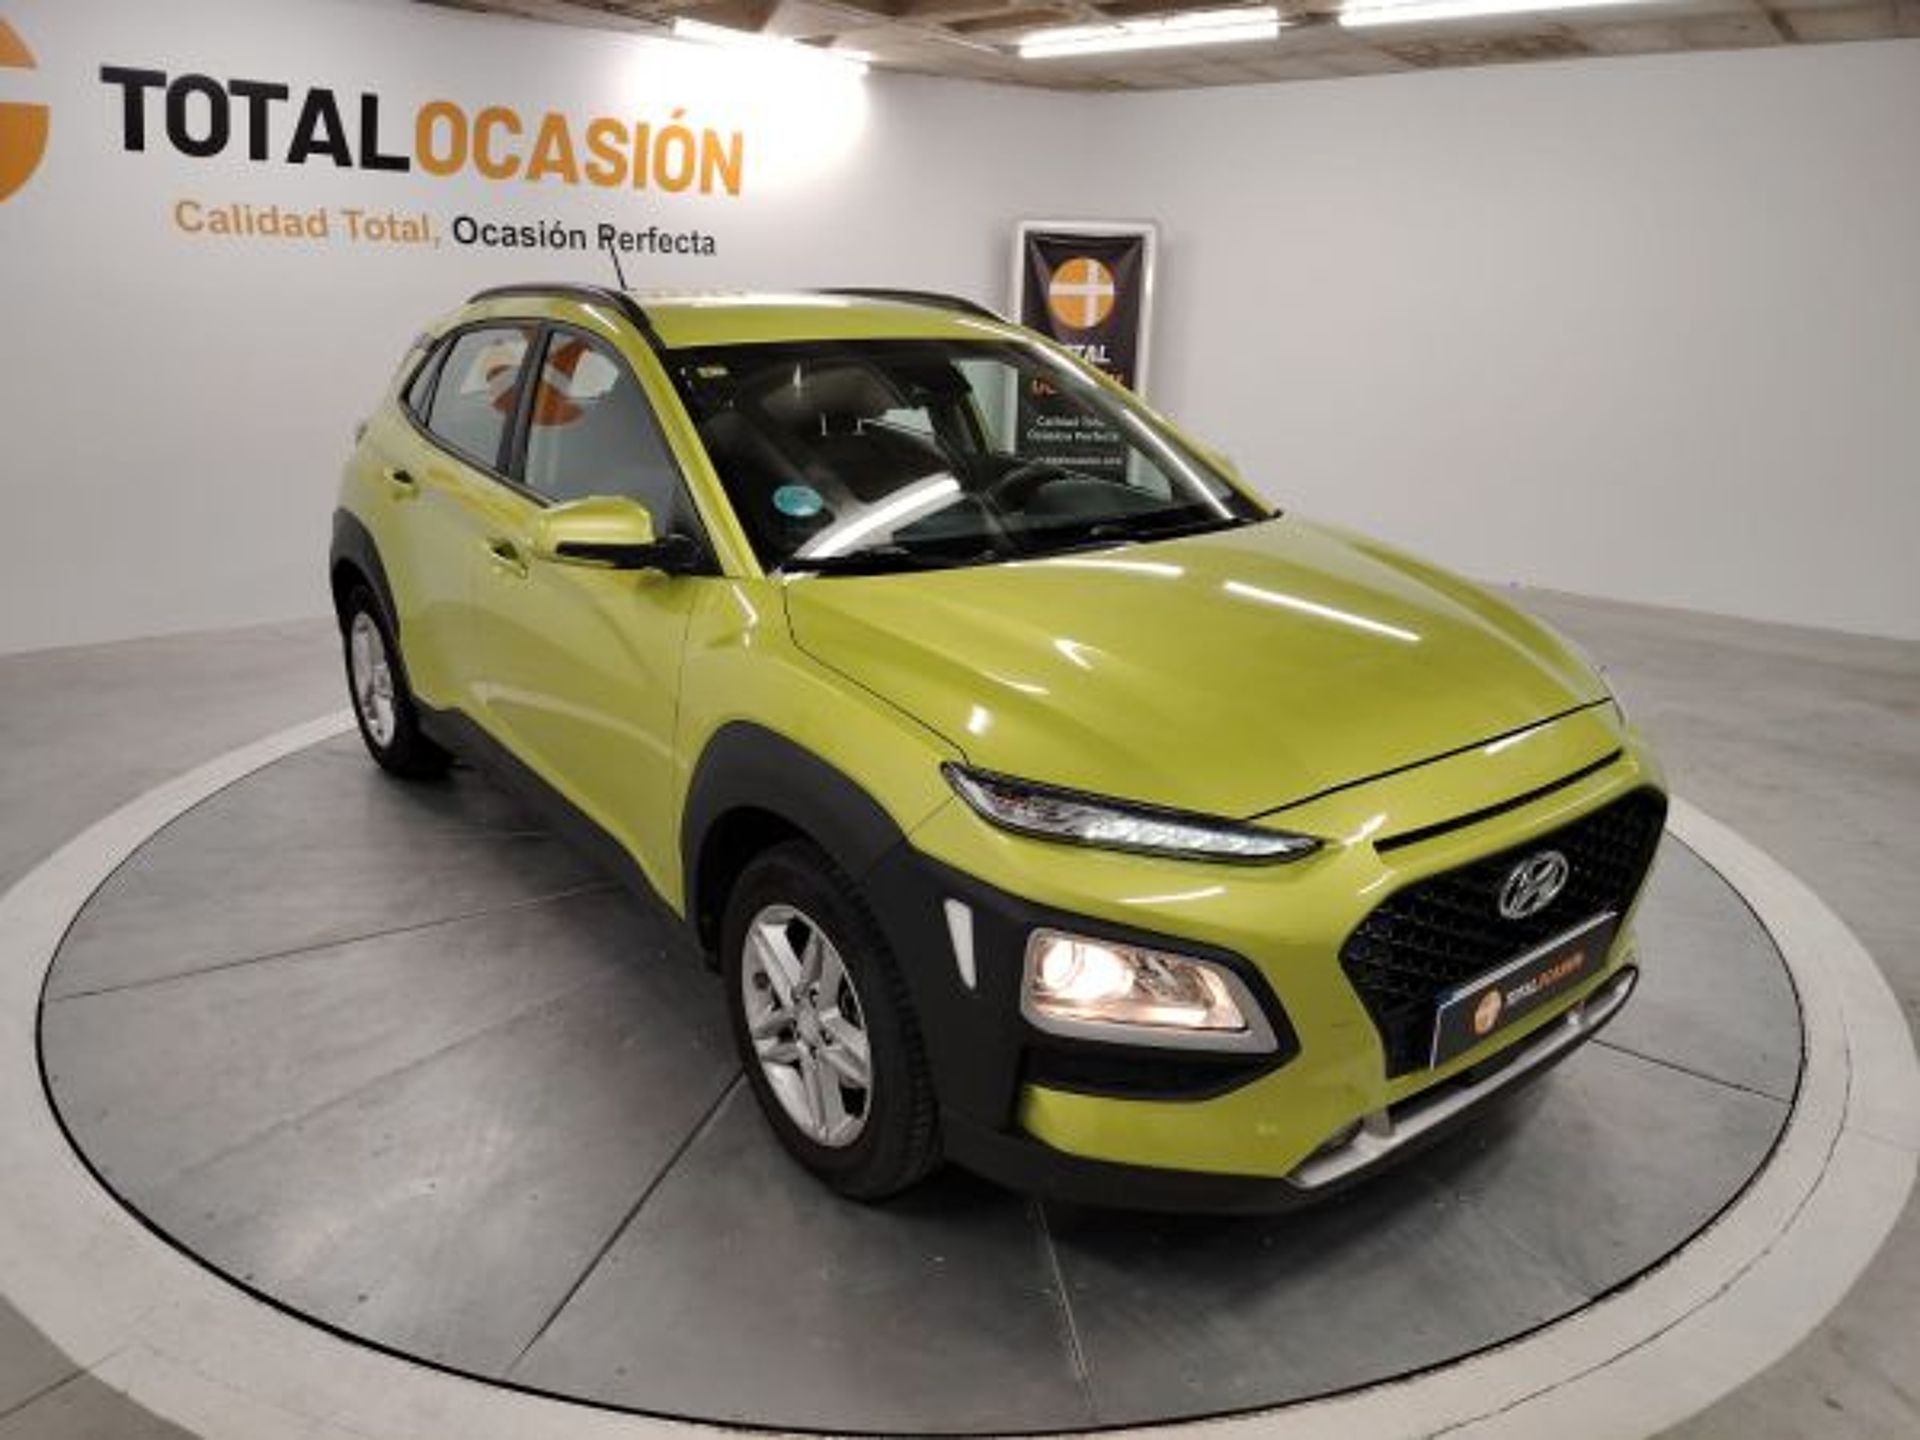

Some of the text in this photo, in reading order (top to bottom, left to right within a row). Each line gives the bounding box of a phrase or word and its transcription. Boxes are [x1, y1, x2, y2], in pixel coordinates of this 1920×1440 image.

[174, 200, 716, 255] Calidad Total, Ocasión Perfecta
